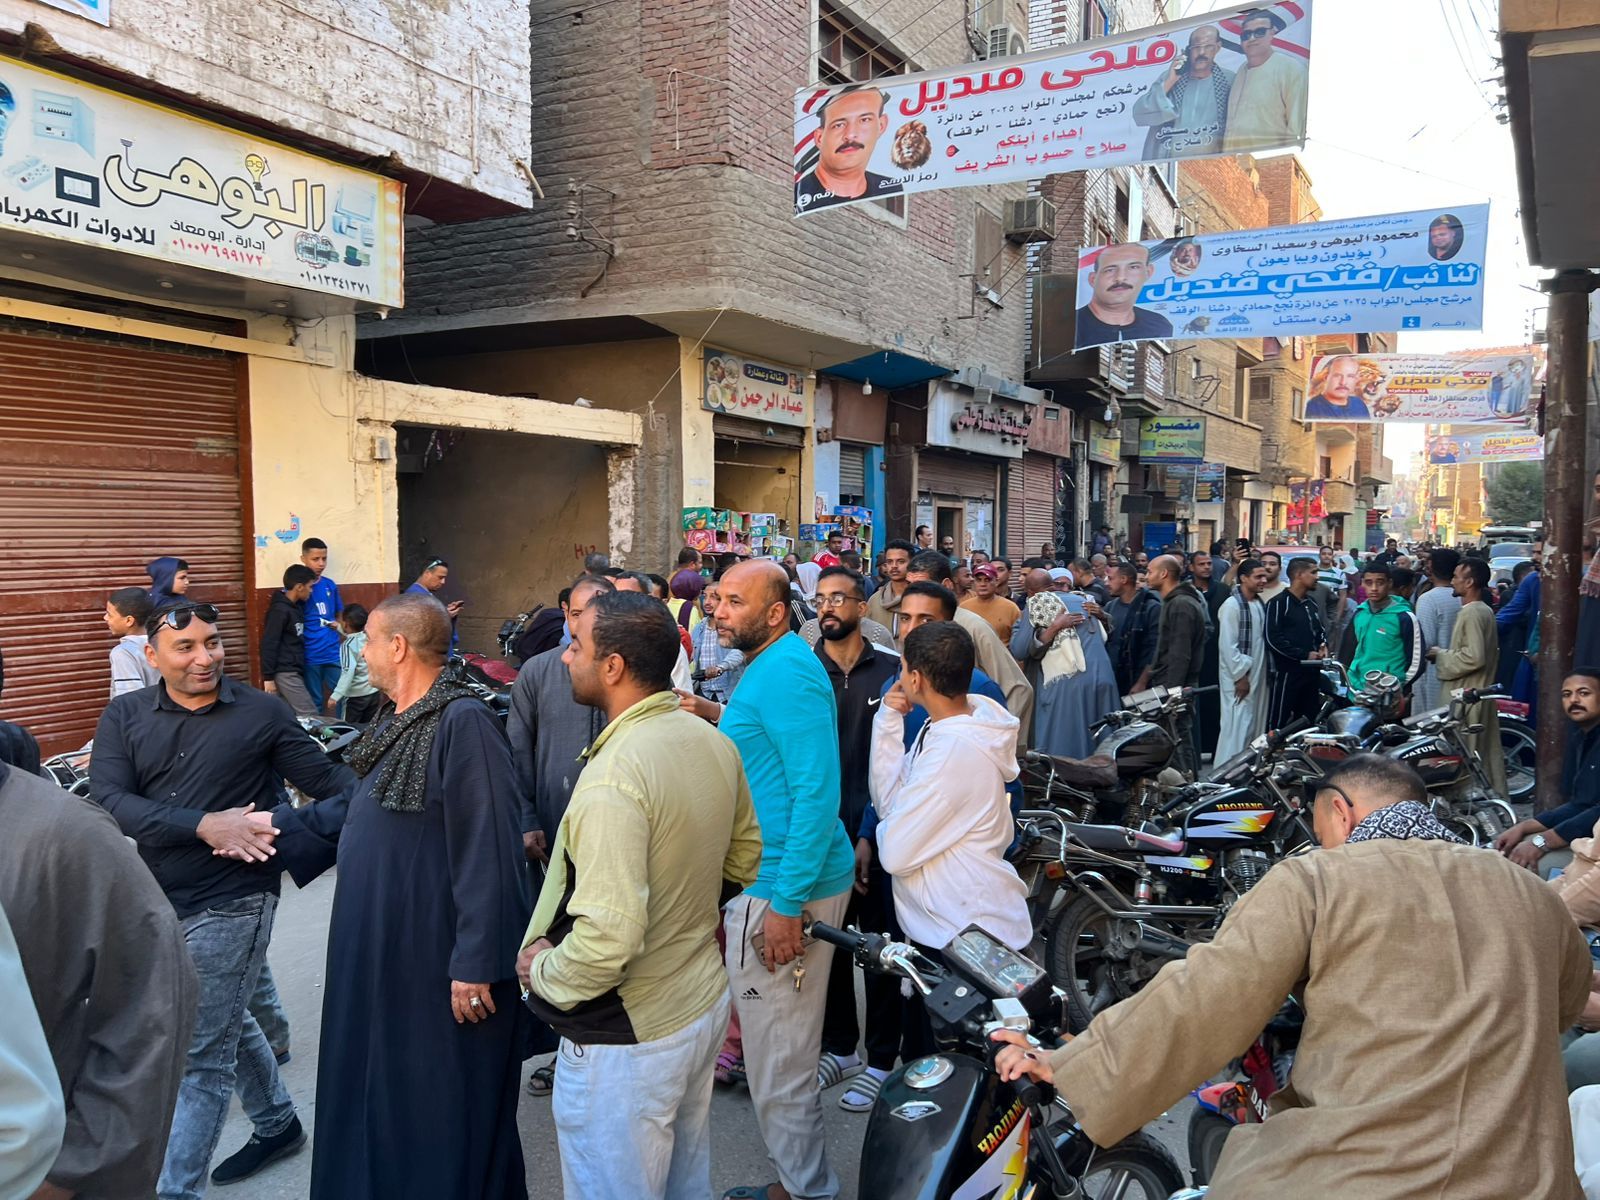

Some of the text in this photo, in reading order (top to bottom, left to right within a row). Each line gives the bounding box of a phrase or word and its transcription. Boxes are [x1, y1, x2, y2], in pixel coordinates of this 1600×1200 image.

[1061, 90, 1095, 106] لمجلس
[1102, 83, 1148, 101] مرشحكم
[1021, 97, 1055, 112] النواب
[937, 112, 963, 126] دائرة
[968, 109, 983, 121] عن
[1009, 118, 1032, 129] دشنا
[954, 141, 1127, 174] صلاح حسوب الشريف
[917, 172, 939, 183] رمز
[103, 153, 325, 239] البوهى
[0, 196, 156, 245] للادوات الكهربا
[170, 219, 205, 237] معاذ
[1321, 234, 1369, 249] البوهى
[1372, 231, 1419, 243] محمود
[1272, 241, 1307, 251] سعيد
[1146, 269, 1259, 303] قنديل
[1295, 300, 1322, 310] دائرة
[1322, 300, 1339, 308] عن
[1344, 297, 1366, 305] ٢٠٢٥
[1370, 297, 1404, 308] النواب
[1405, 296, 1438, 306] مجلس
[1440, 294, 1472, 305] مرشح
[1169, 305, 1200, 315] الوقف
[1208, 303, 1231, 312] دشنا
[1273, 300, 1294, 313] نجع
[1272, 315, 1317, 326] مستقل
[747, 366, 785, 385] بقالة وعطارة
[740, 386, 804, 417] عباد الرحمن
[1144, 418, 1201, 433] منصور
[315, 602, 327, 615] 10
[1216, 802, 1265, 811] HAOJIANG
[977, 1096, 1025, 1157] HAOJIAN
